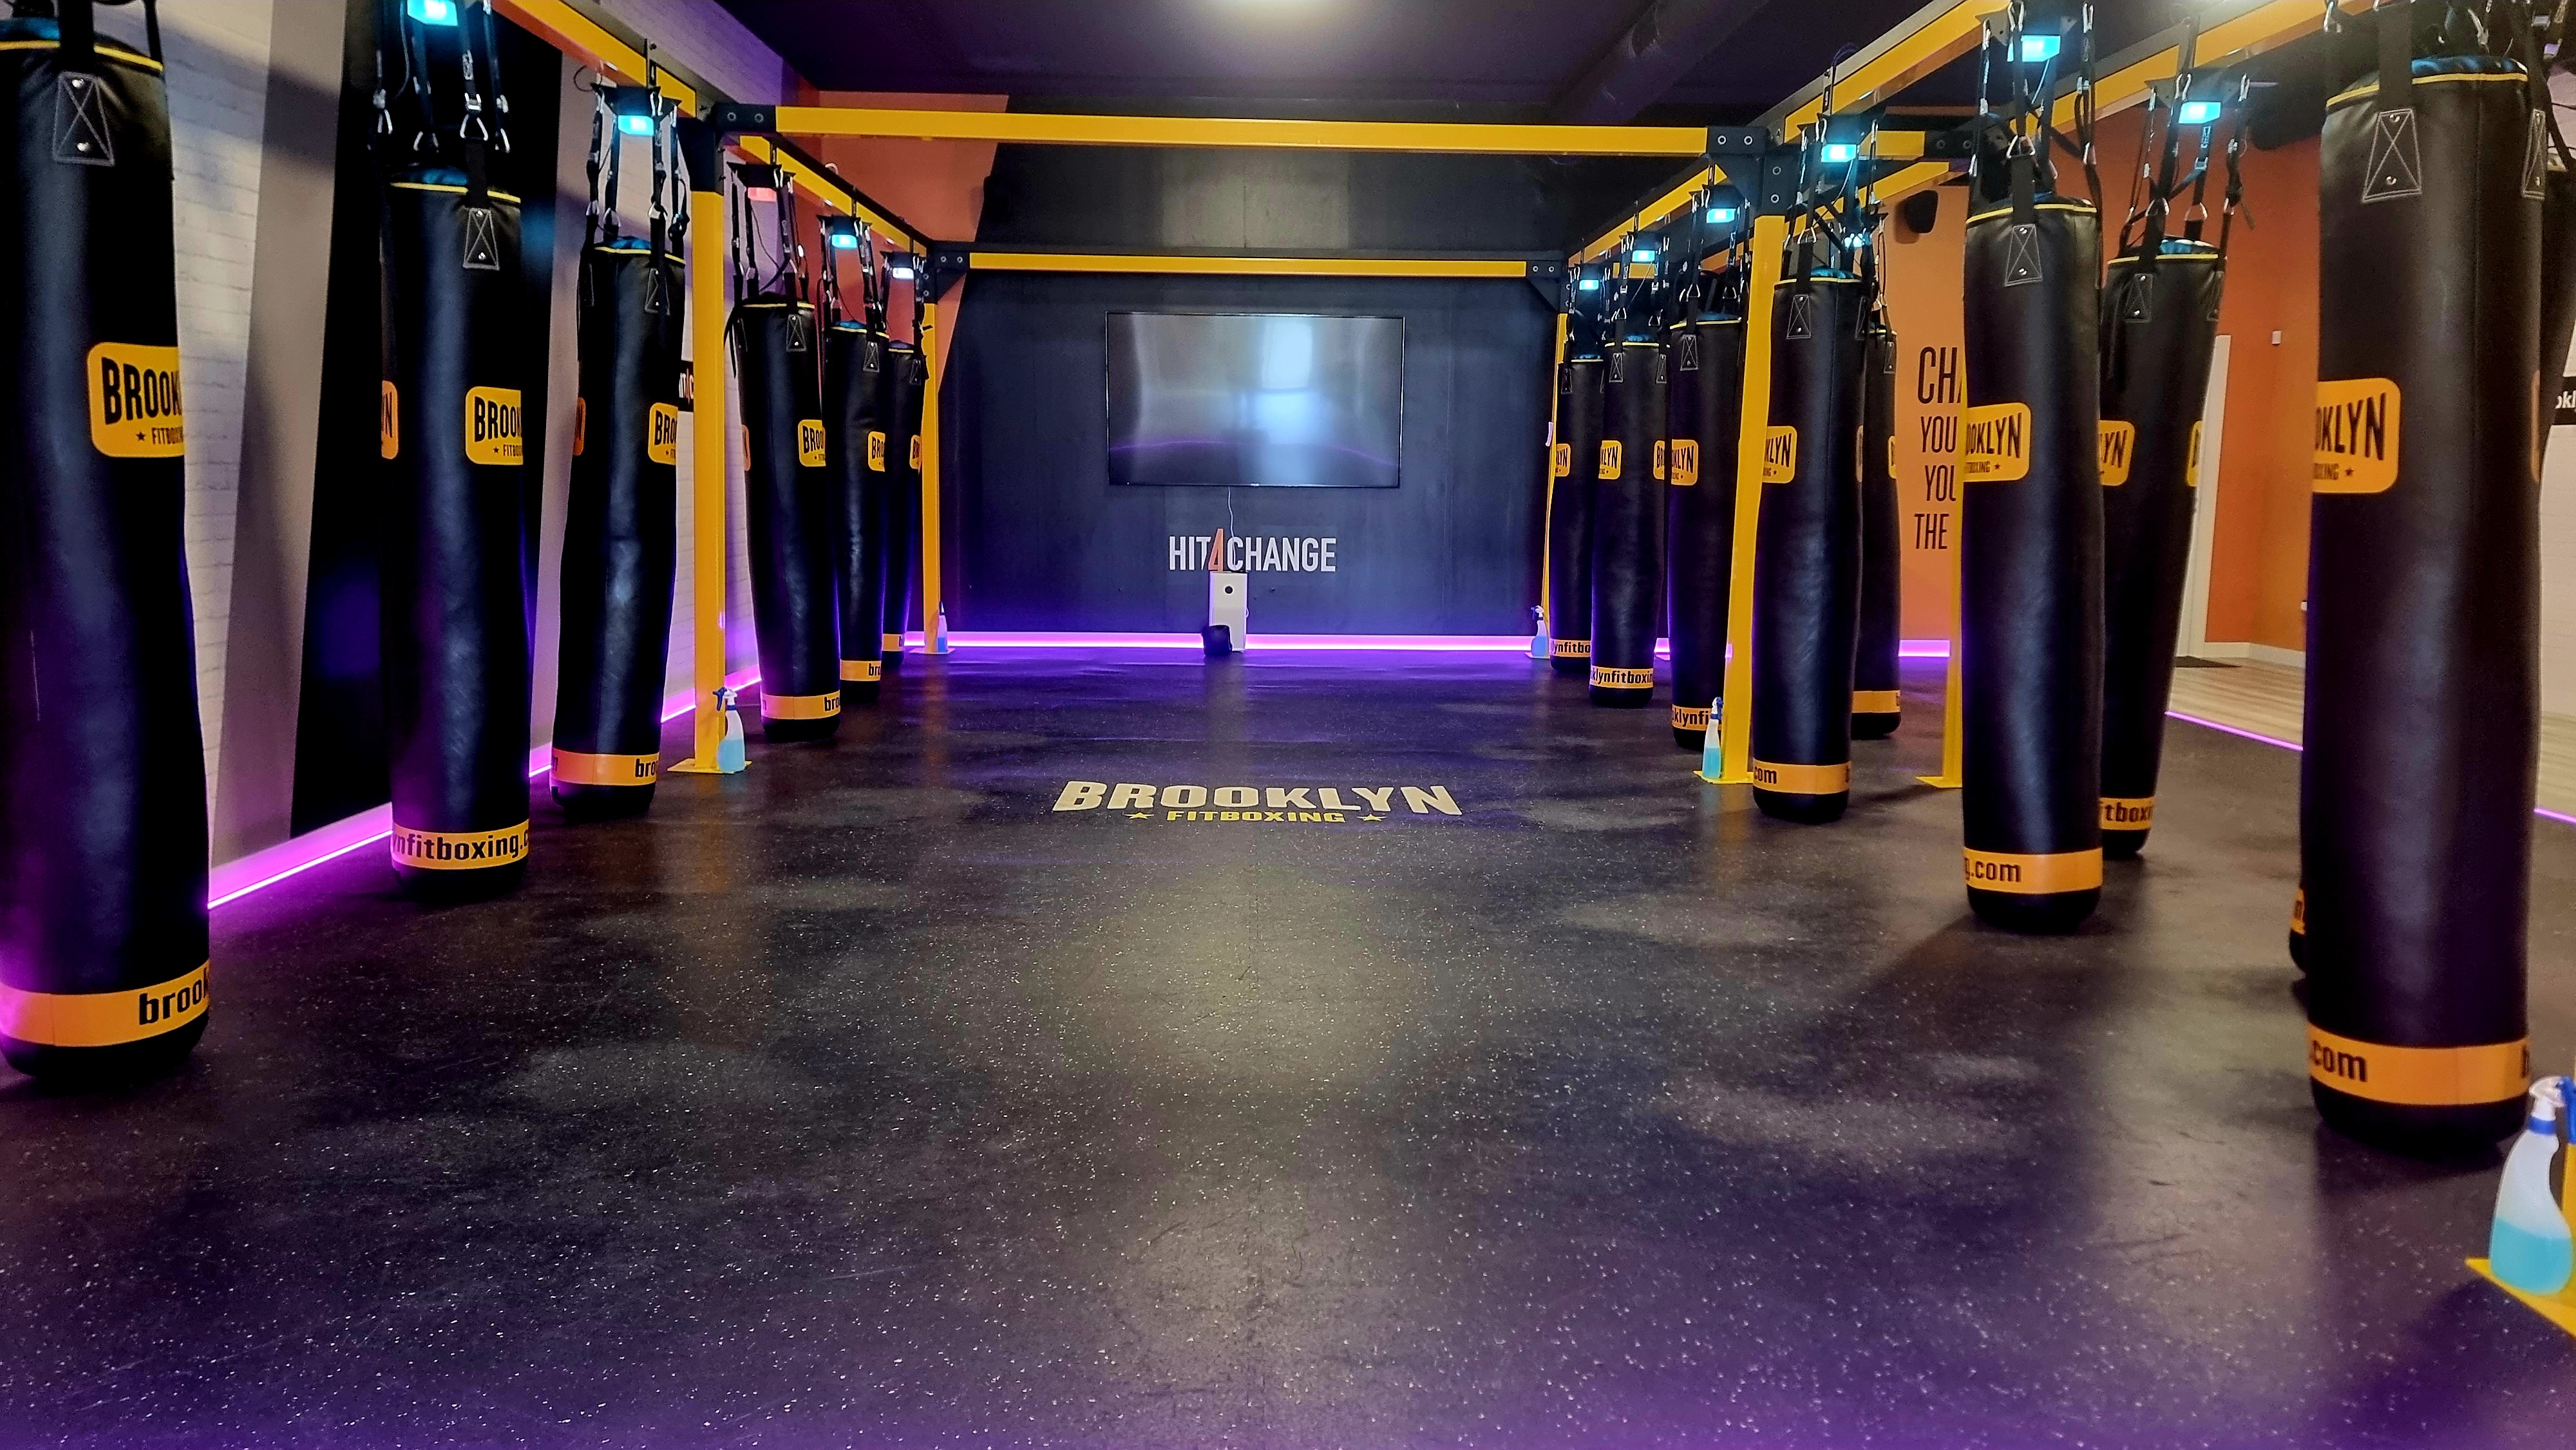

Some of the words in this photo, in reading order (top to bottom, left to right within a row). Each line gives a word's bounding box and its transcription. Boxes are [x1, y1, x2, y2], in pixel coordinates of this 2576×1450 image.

[1917, 346, 1962, 404] CH
[1920, 416, 1958, 453] YOU
[1914, 513, 1950, 550] THE
[1052, 780, 1463, 816] BROOKLYN
[1166, 811, 1346, 823] FITBOXING
